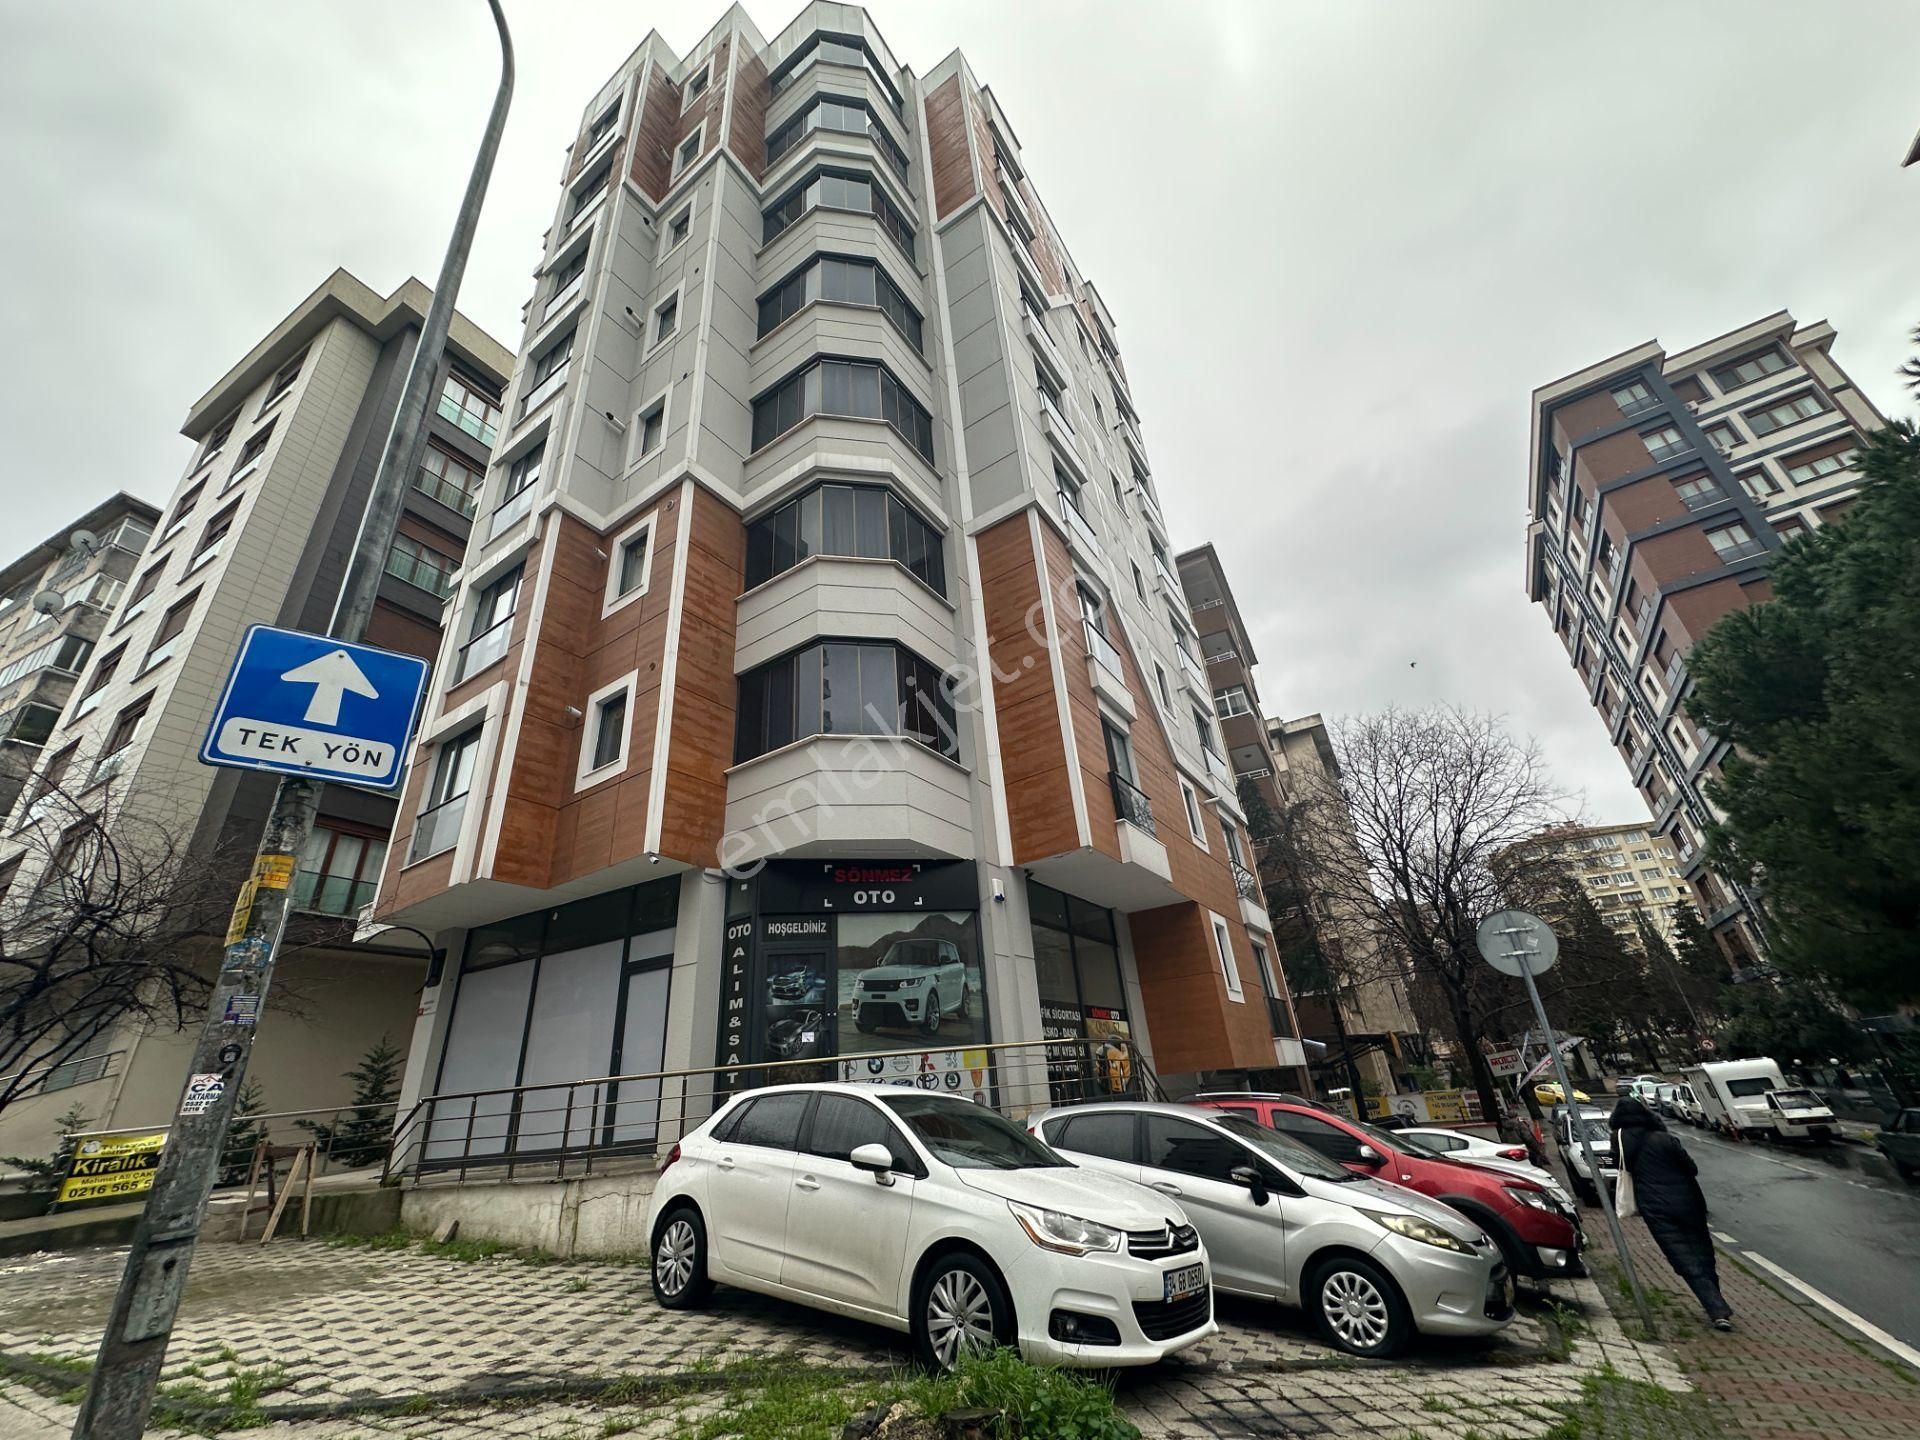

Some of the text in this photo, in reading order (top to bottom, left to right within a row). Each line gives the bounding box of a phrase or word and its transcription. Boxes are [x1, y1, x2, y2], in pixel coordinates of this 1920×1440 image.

[238, 728, 301, 754] TEK
[323, 743, 382, 768] YÖN
[834, 866, 913, 883] SÖNMEZ
[853, 890, 896, 905] OTO
[728, 923, 752, 940] OTO
[768, 920, 827, 937] HOŞGELDİNİZ
[1052, 1044, 1085, 1057] MUAYENSİ
[72, 1155, 148, 1175] Kiralık
[69, 1185, 106, 1198] 0216
[111, 1180, 139, 1193] 565
